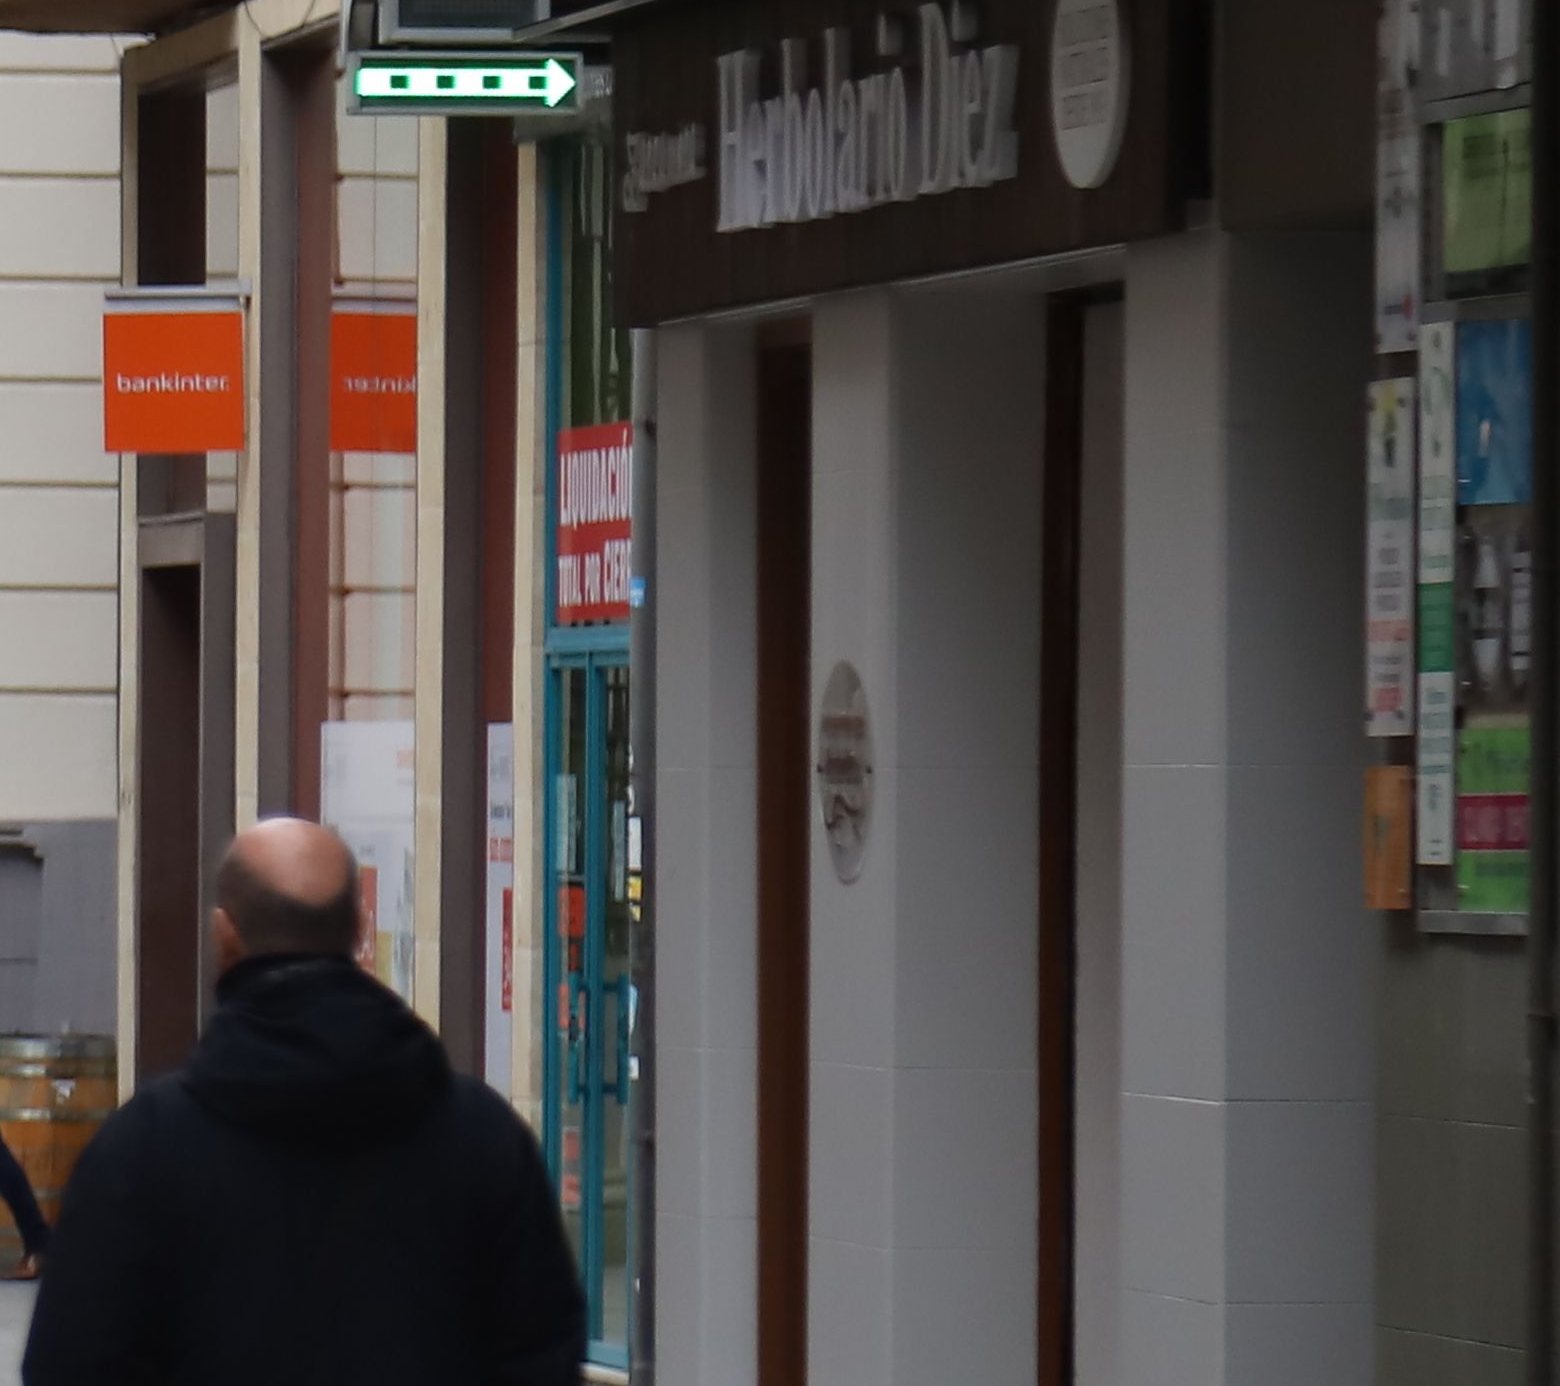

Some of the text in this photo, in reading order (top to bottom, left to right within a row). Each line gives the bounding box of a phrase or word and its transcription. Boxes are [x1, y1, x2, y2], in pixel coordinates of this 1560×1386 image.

[715, 11, 910, 234] Herbolario
[558, 538, 632, 606] TOTAL POR CIERR
